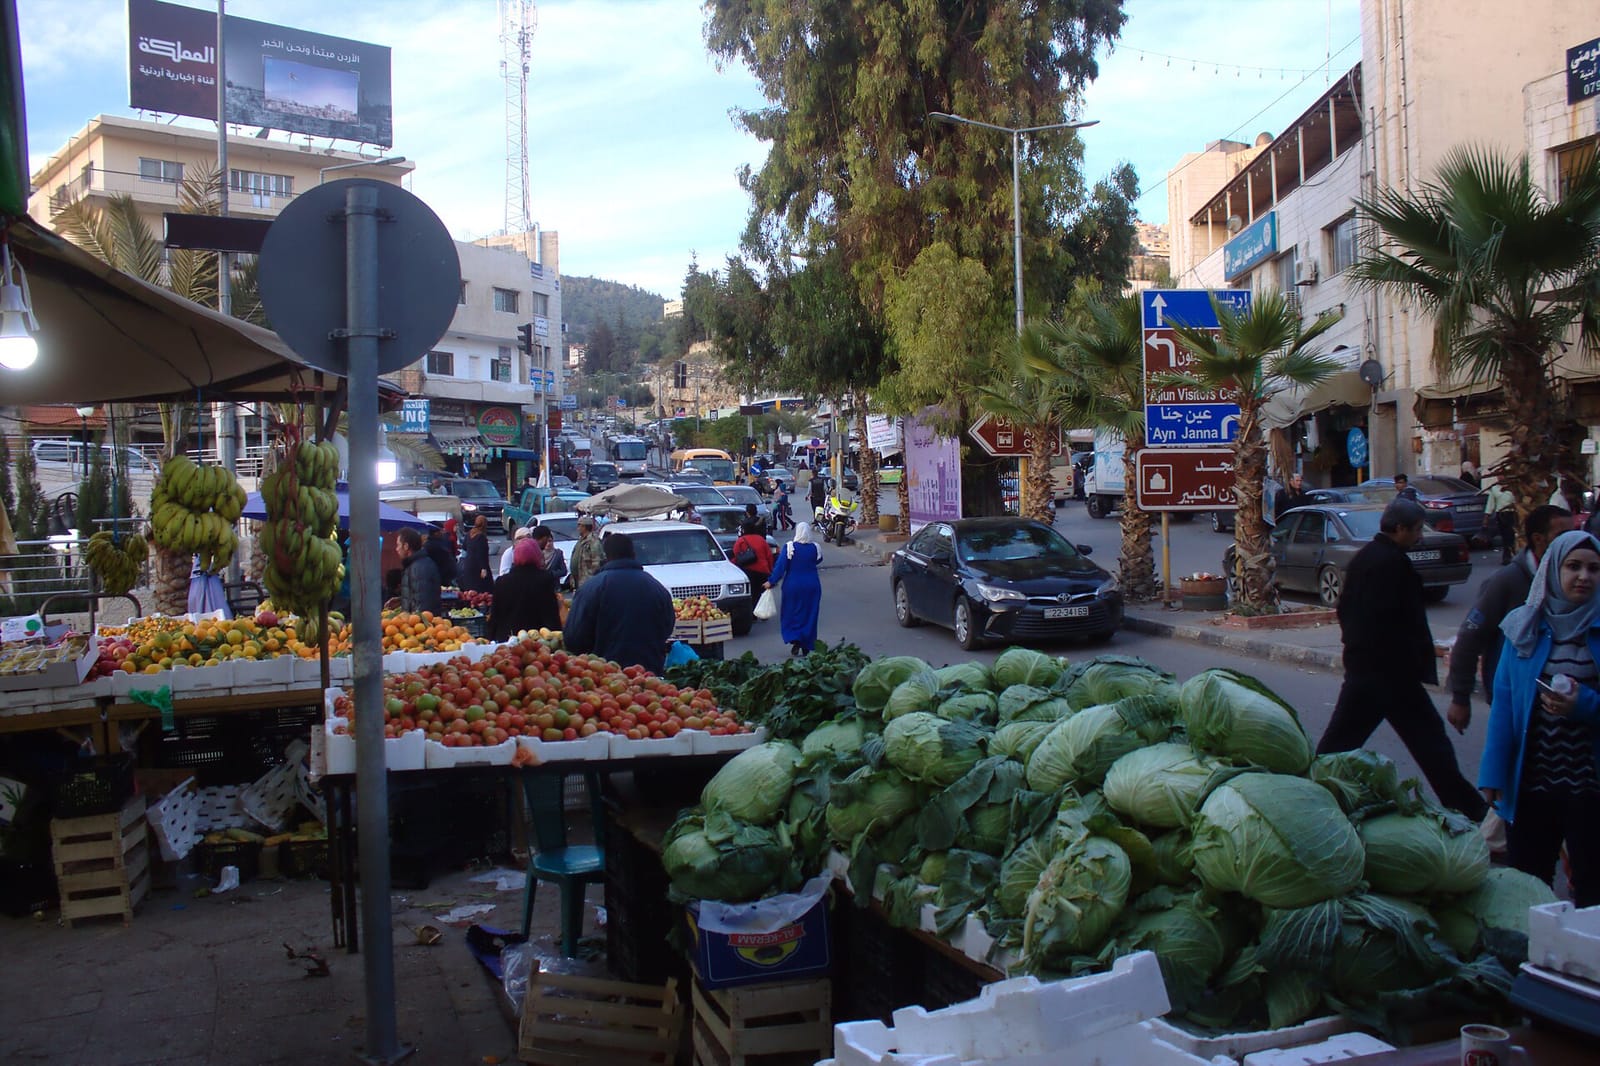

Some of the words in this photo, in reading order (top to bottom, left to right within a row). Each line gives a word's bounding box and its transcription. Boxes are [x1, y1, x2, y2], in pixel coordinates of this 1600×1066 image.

[139, 37, 214, 64] المملكة
[261, 39, 284, 49] الخبر
[286, 42, 310, 55] ونحن
[336, 52, 360, 63] الأردن
[139, 65, 164, 77] أردنية
[166, 69, 195, 85] إخبارية
[197, 75, 215, 85] قناة
[1160, 406, 1183, 422] جنا
[1185, 409, 1212, 424] عين
[1181, 426, 1218, 440] Janna
[1178, 484, 1216, 504] الكبير
